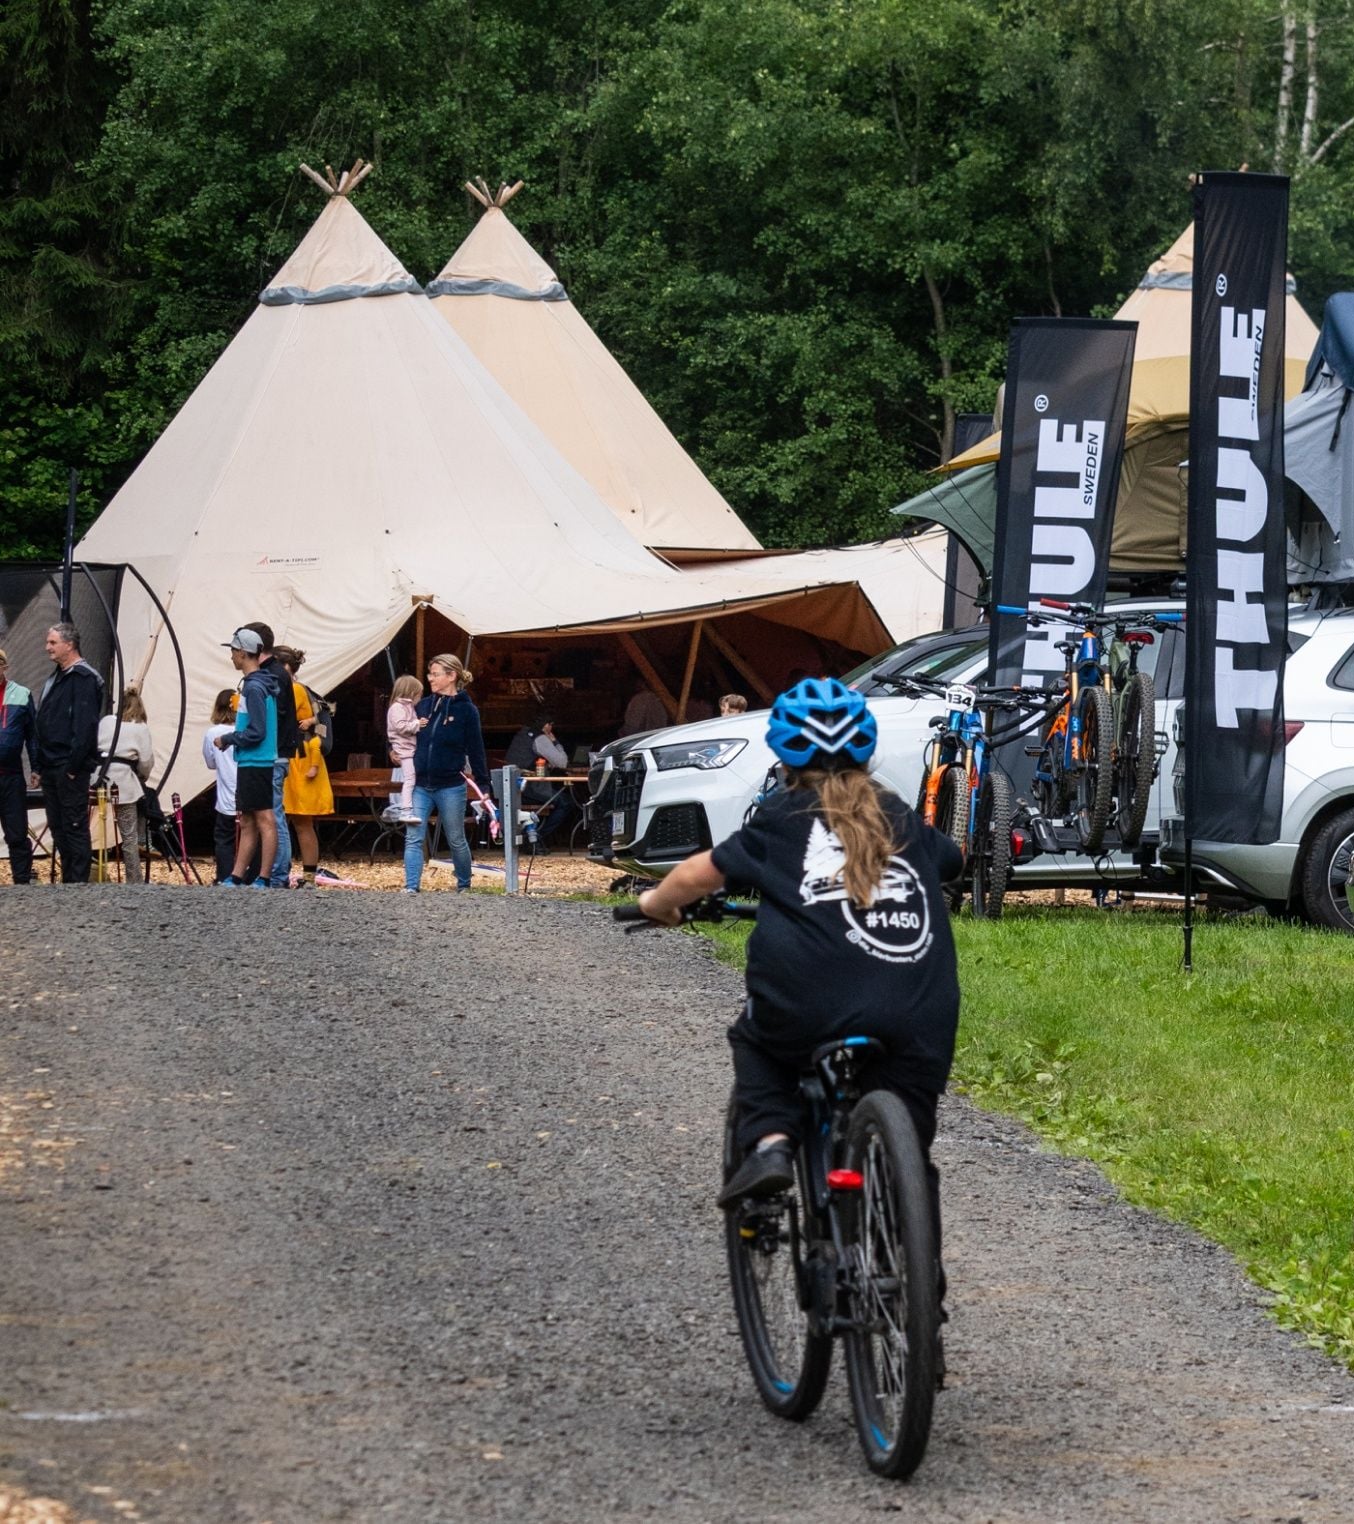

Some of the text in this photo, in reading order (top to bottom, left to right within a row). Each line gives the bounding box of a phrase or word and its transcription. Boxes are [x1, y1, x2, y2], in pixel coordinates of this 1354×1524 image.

[1084, 433, 1099, 505] SWEDEN
[948, 693, 972, 707] 134
[865, 911, 920, 929] #1450
